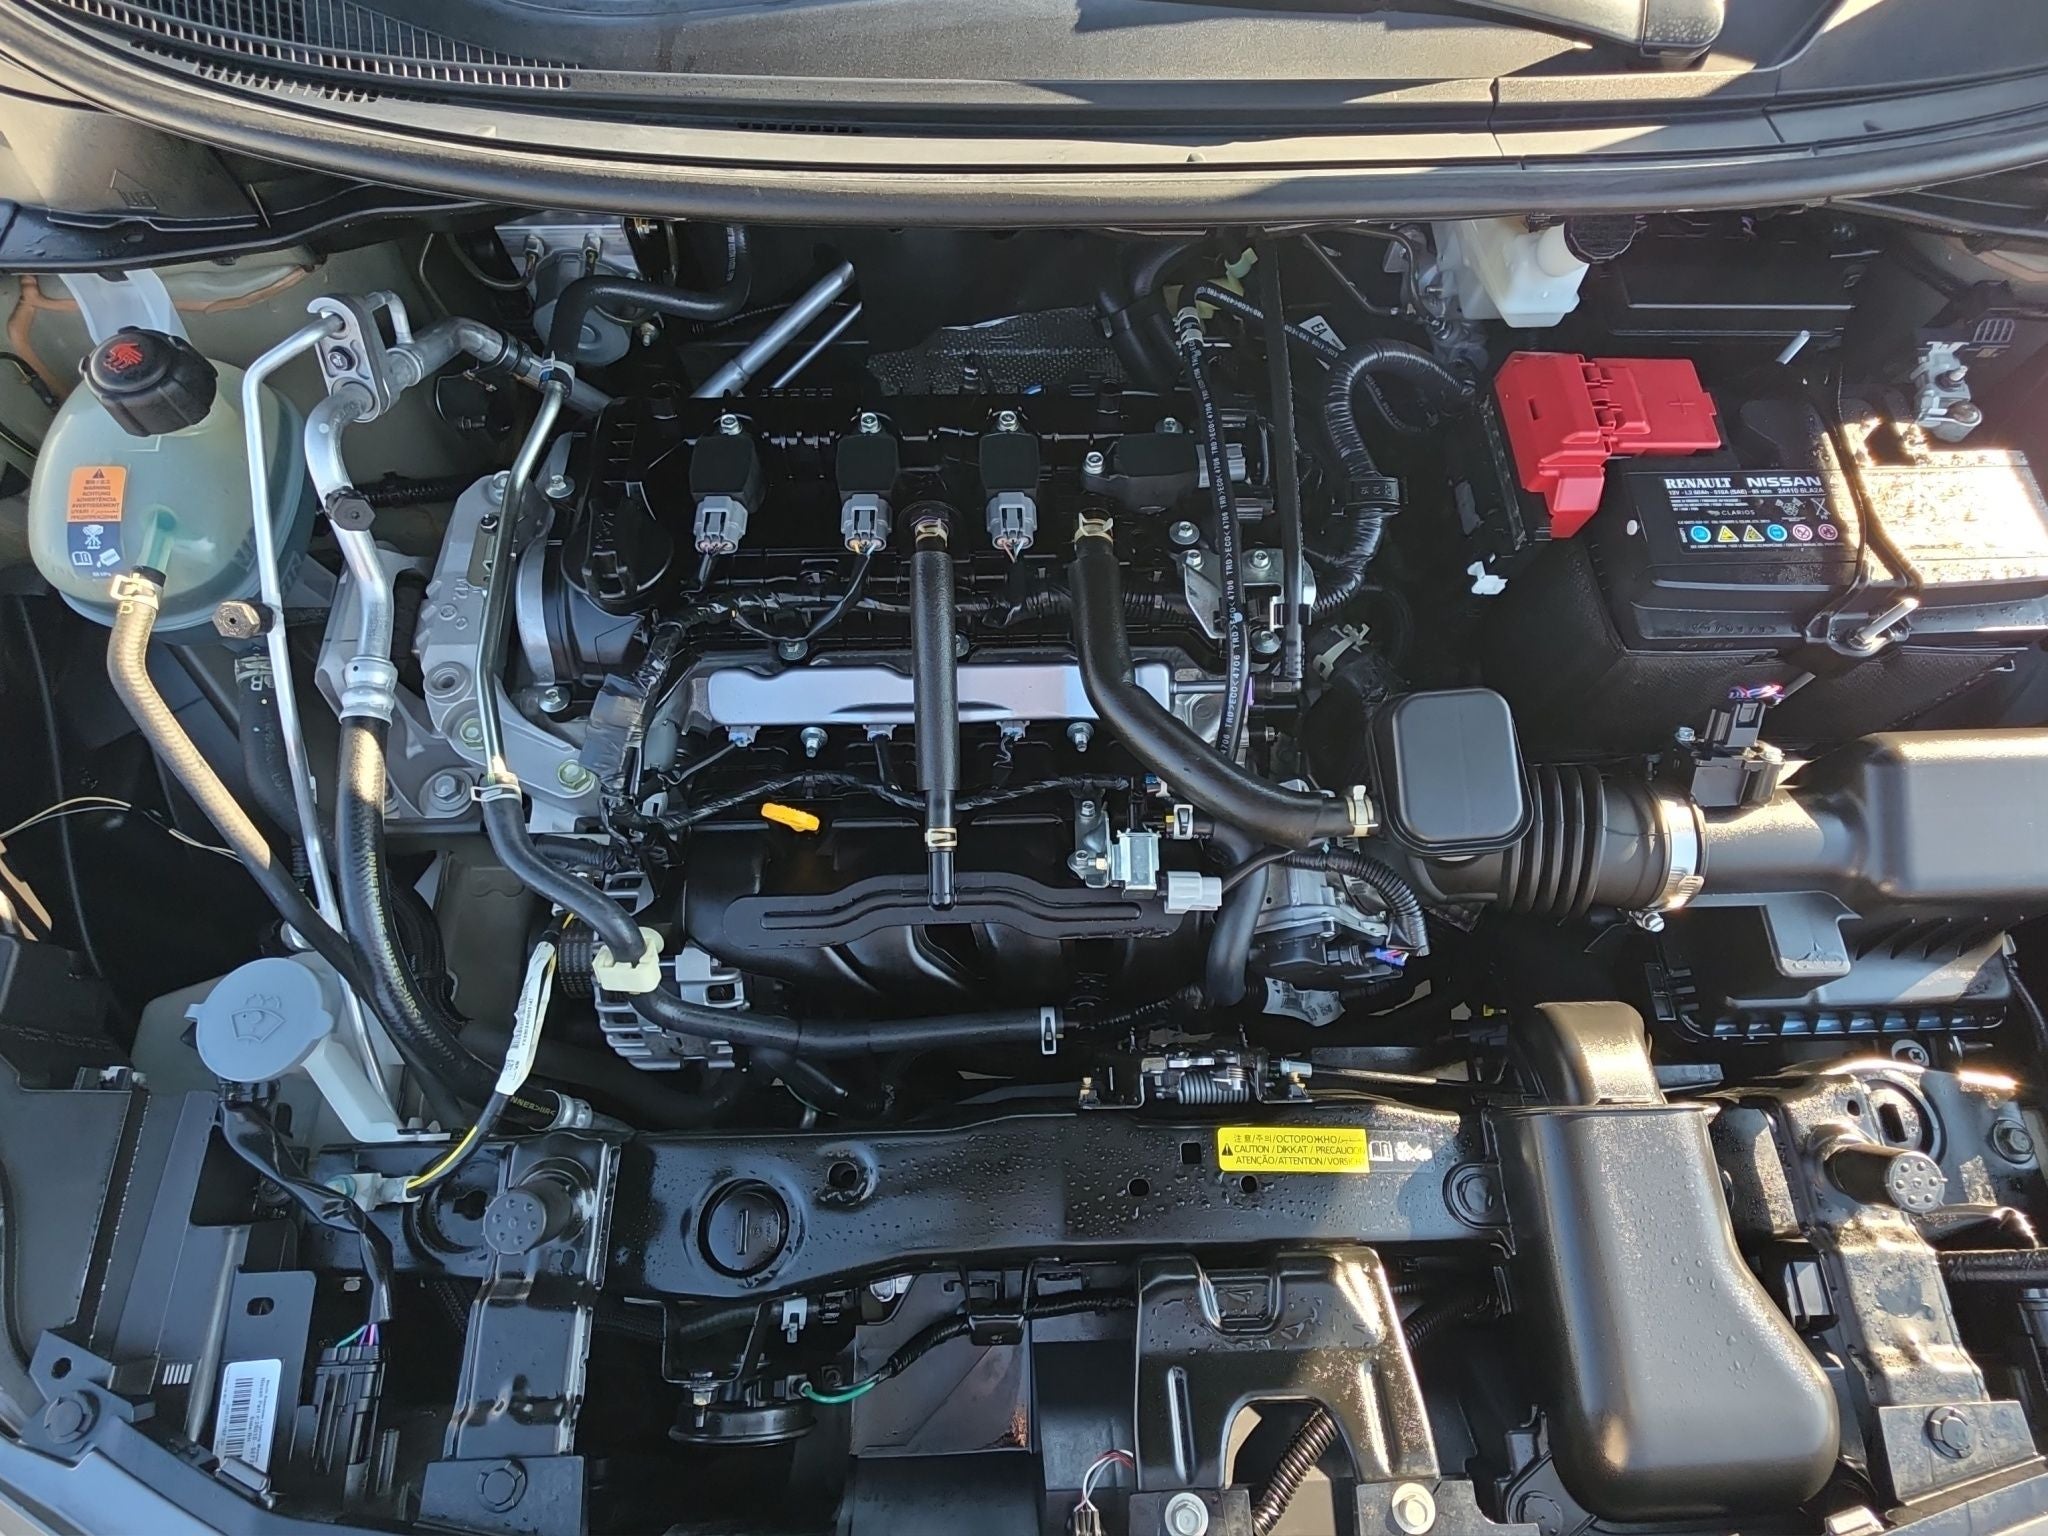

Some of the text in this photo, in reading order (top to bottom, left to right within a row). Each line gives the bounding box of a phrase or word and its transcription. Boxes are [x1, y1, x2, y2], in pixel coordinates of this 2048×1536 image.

[1664, 478, 1731, 489] RENAULT
[1746, 476, 1822, 487] NISSAN
[1234, 1144, 1270, 1153] CAUTION
[1276, 1145, 1308, 1154] DIKKAT
